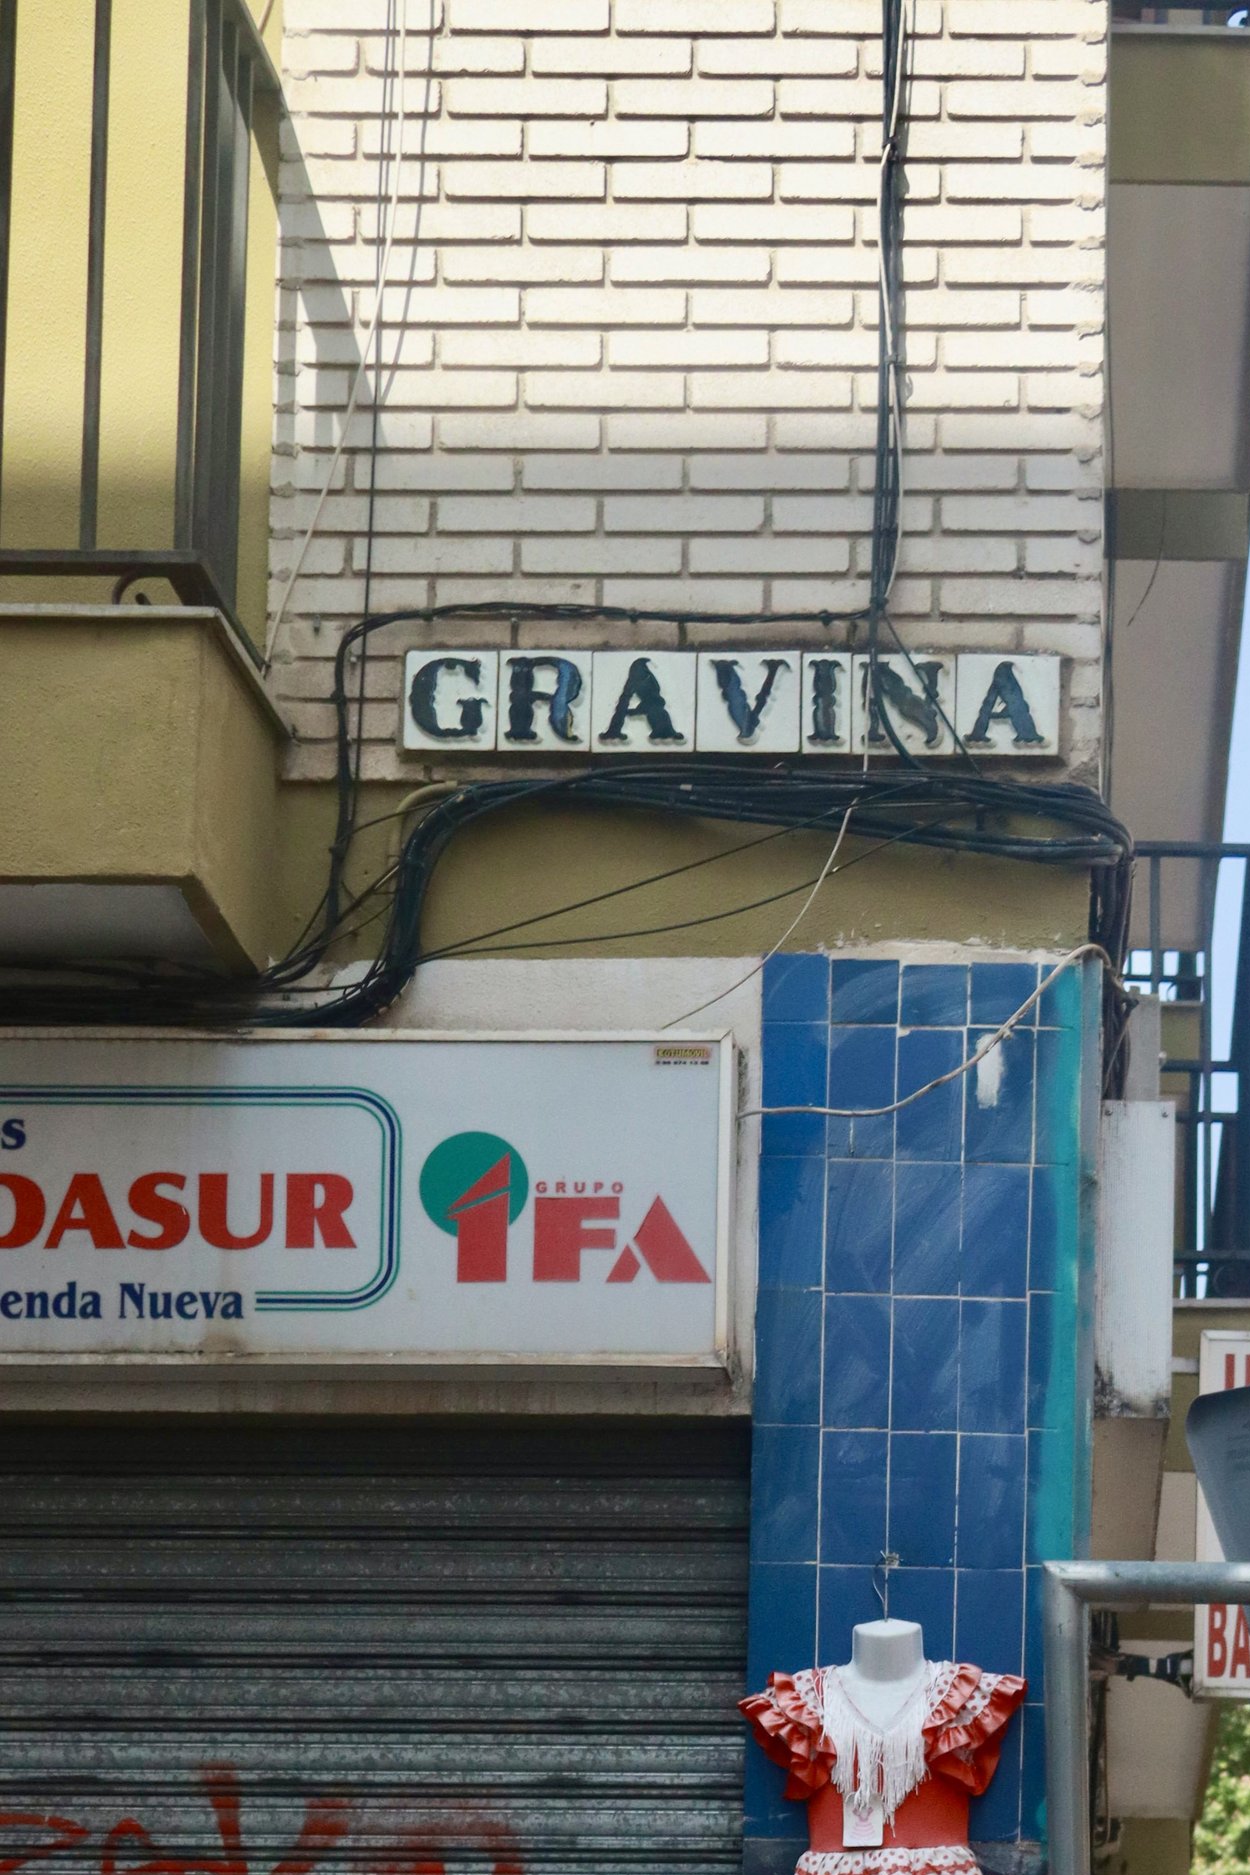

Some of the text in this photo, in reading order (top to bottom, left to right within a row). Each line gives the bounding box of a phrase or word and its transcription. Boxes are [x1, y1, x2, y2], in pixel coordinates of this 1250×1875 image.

[410, 656, 1045, 745] GRAVINA
[535, 1181, 624, 1194] GRUPO
[118, 1283, 244, 1320] Nueva
